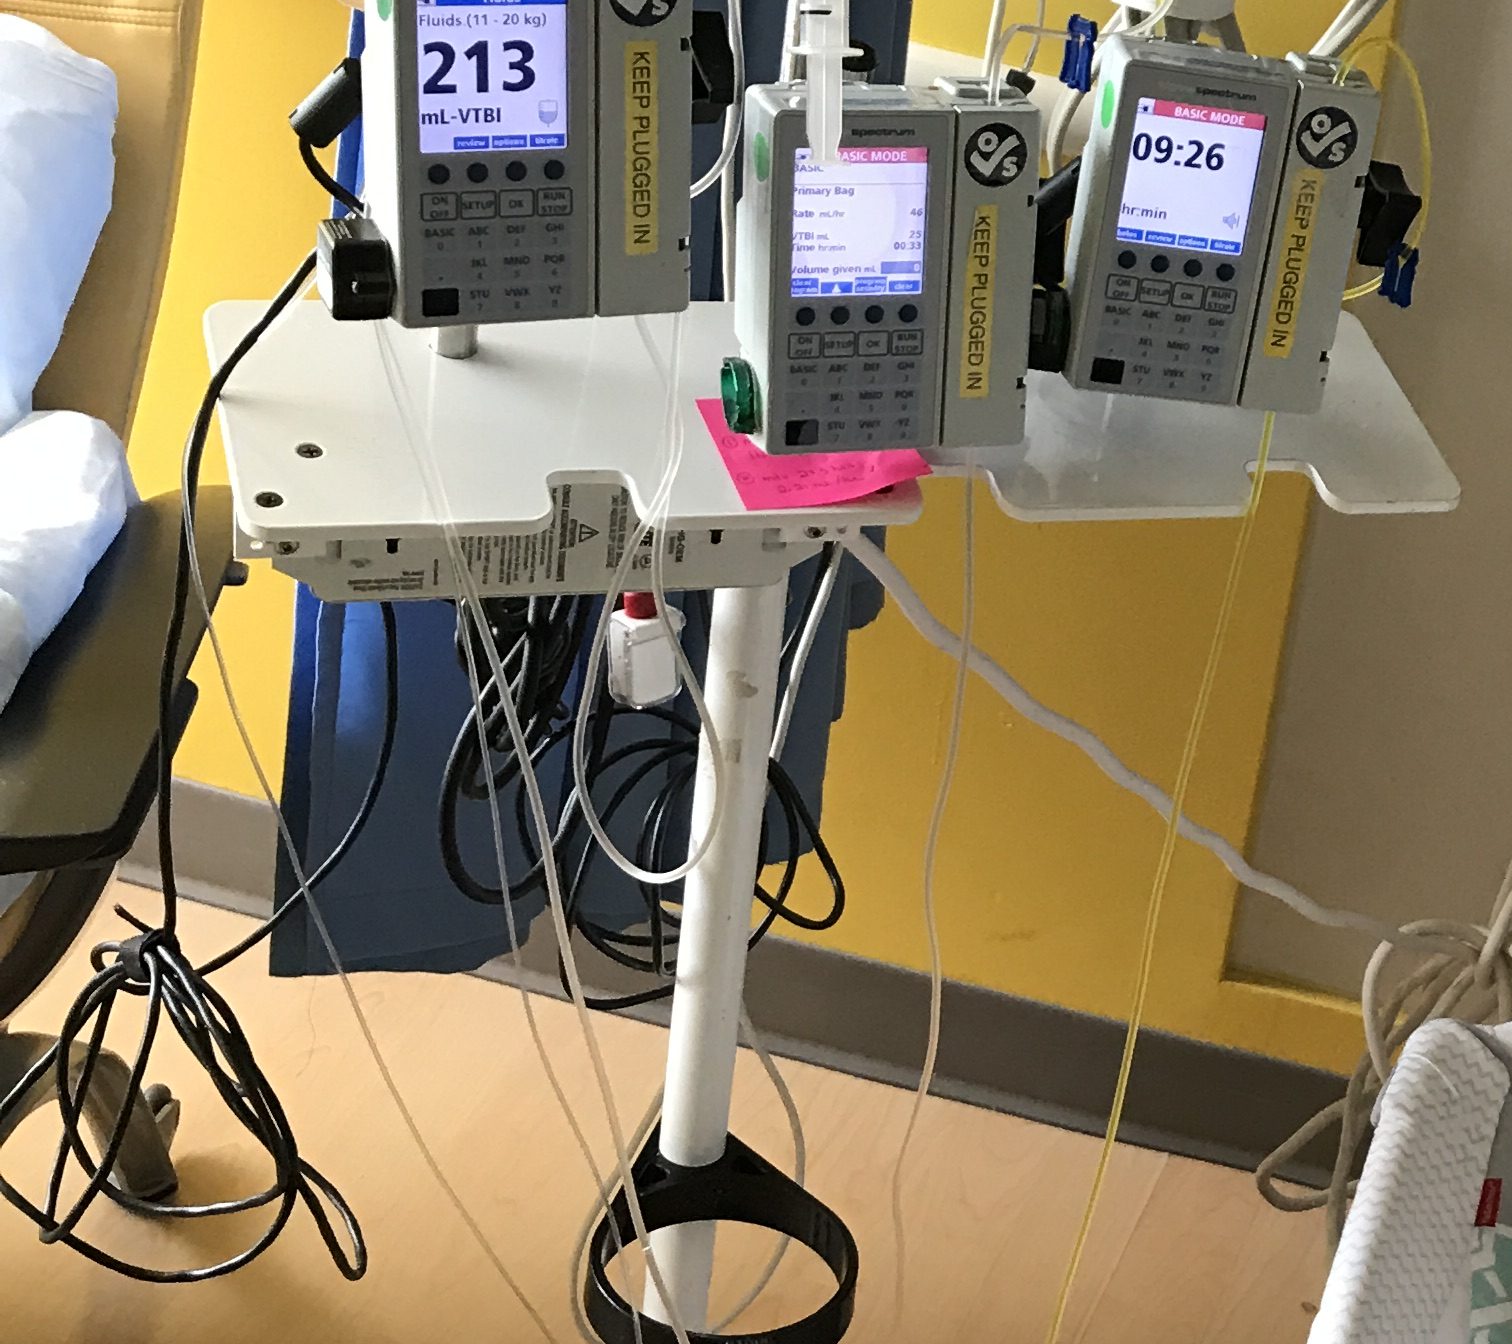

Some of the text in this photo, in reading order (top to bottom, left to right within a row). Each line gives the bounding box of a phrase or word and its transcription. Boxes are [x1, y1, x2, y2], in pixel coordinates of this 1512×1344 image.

[466, 12, 488, 29] (11
[503, 13, 520, 26] 20
[524, 12, 547, 29] kg)
[422, 39, 536, 95] 213
[1196, 86, 1257, 101] spectrum
[420, 107, 502, 125] mL-VTBI
[1175, 106, 1246, 126] BASIC MODE
[851, 128, 915, 138] spectrum
[632, 51, 651, 244] KEEP PLUGGED IN
[871, 150, 907, 162] MODE
[1132, 133, 1226, 171] 09:26
[834, 186, 855, 197] Bag
[910, 208, 923, 217] 46
[1122, 203, 1167, 220] hr:min
[909, 230, 922, 239] 25
[893, 241, 922, 250] 00:33
[832, 265, 862, 276] given
[1271, 179, 1317, 348] KEEP PLUGGED IN
[966, 216, 990, 390] KEEP PLUGGED IN
